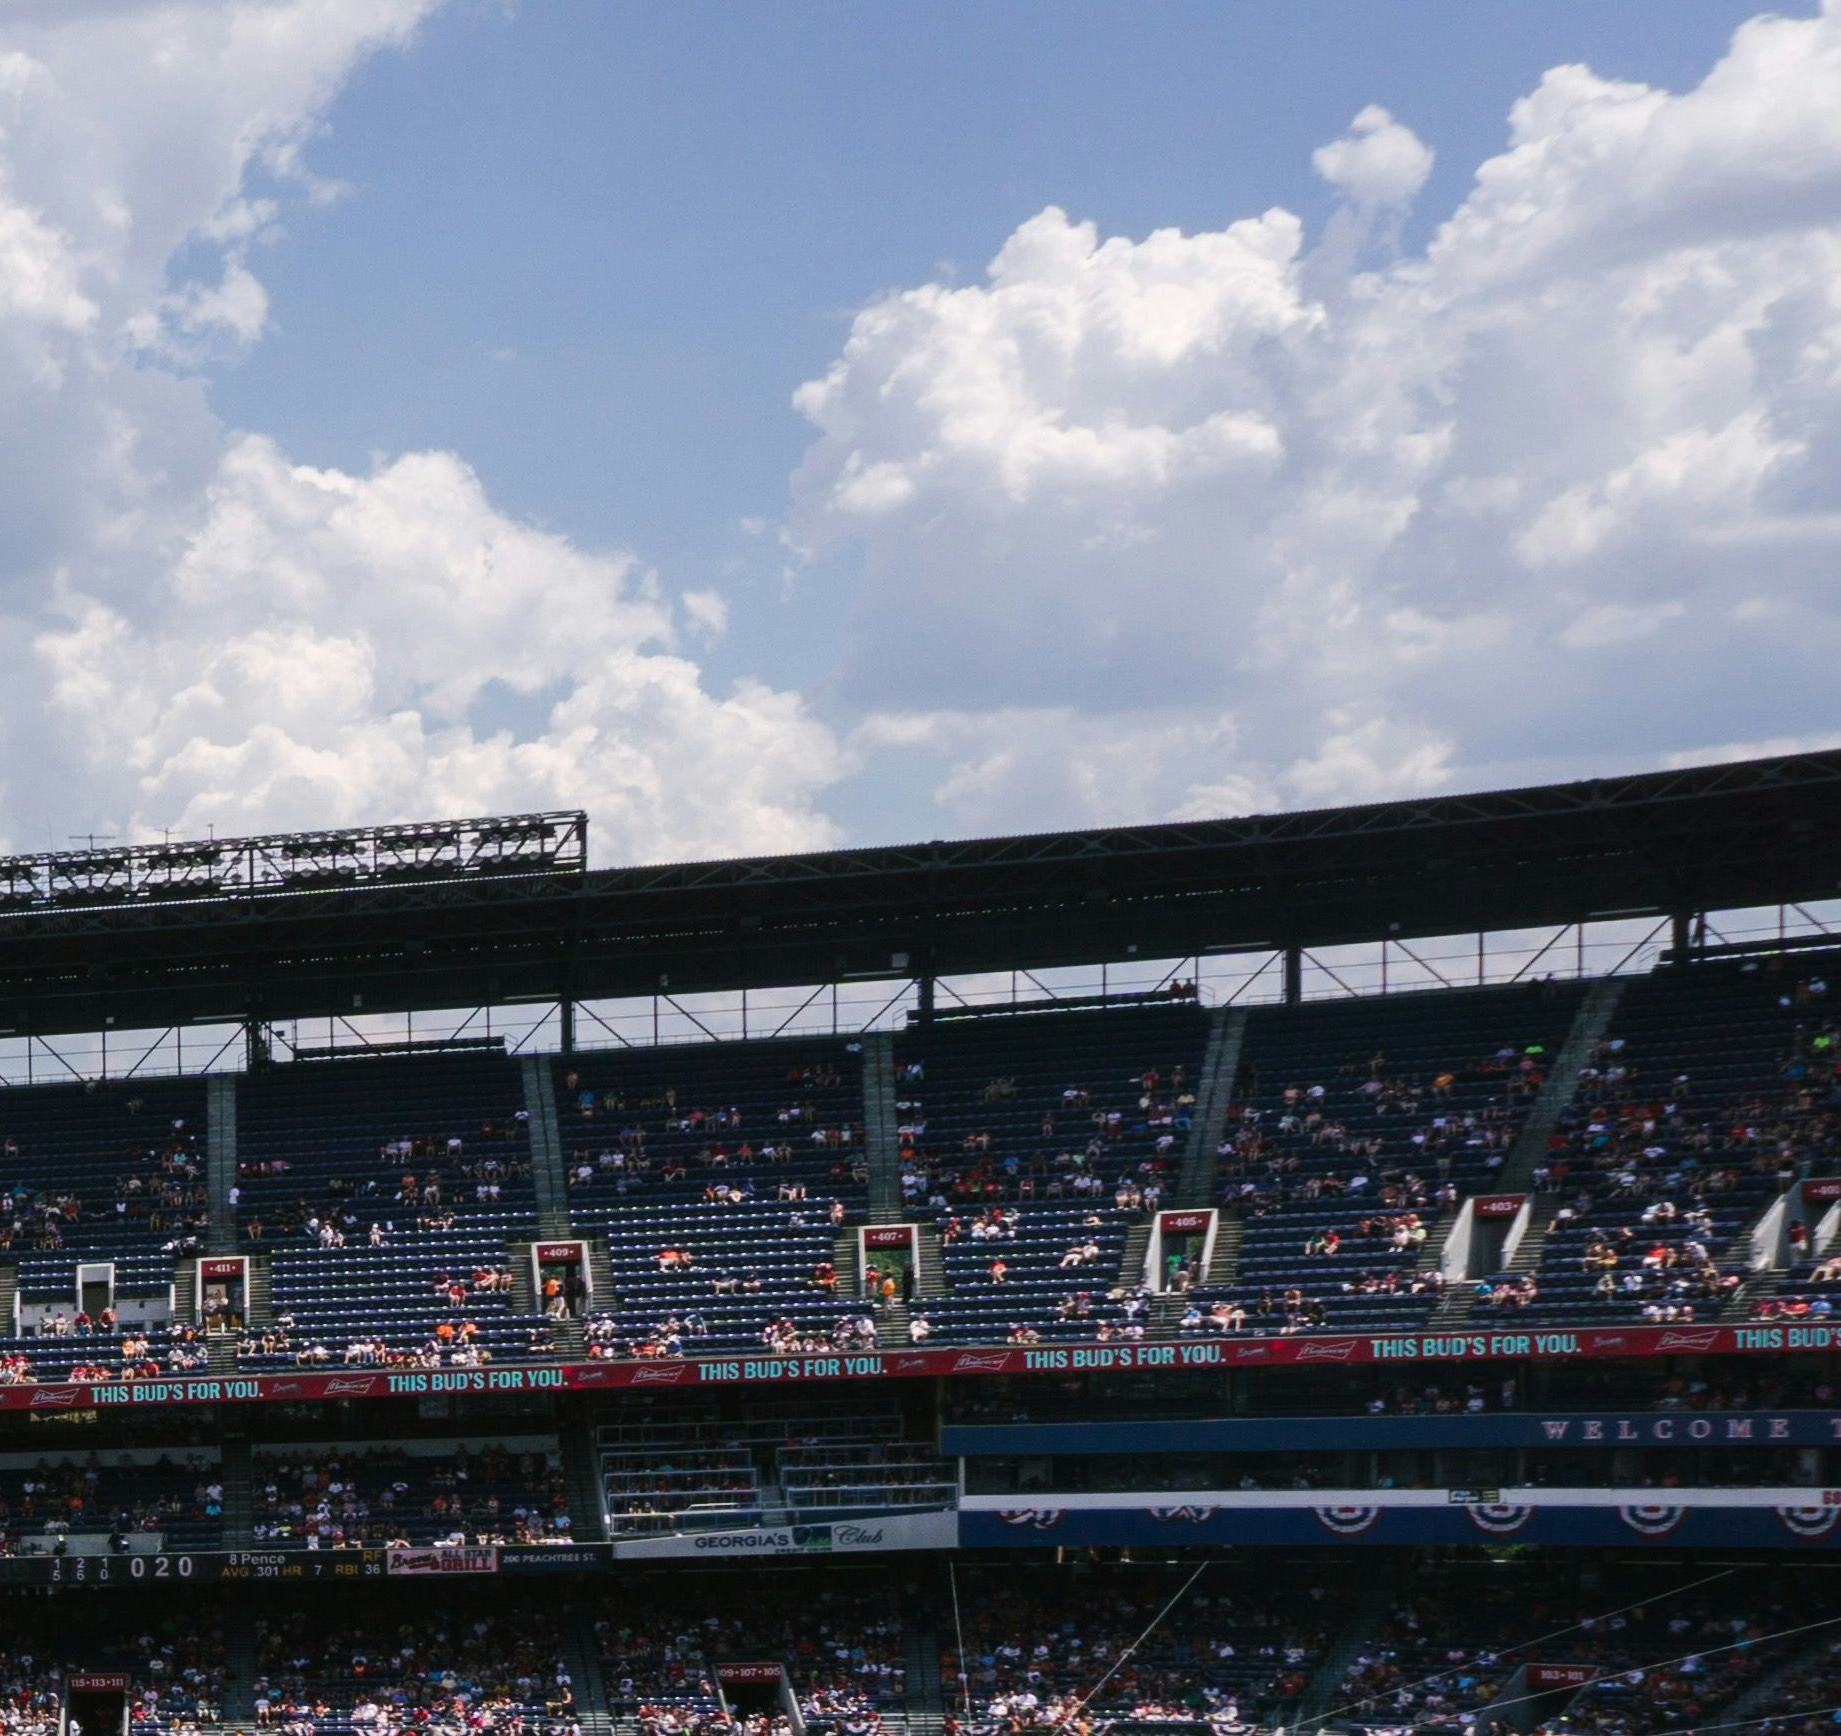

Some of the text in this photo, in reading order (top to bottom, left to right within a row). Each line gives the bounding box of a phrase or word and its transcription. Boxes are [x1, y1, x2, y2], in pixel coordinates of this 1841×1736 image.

[1371, 1335, 1581, 1357] THIS BUD'S FOR YOU.
[1024, 1351, 1068, 1368] THIS
[1073, 1349, 1132, 1367] BUD'S
[1137, 1347, 1175, 1364] FOR
[1180, 1346, 1226, 1363] YOU.
[698, 1358, 887, 1380] THIS BUD'S FOR YOU.
[388, 1370, 568, 1391] THIS BUD'S FOR YOU.
[91, 1382, 263, 1402] THIS BUD'S FOR YOU.
[1540, 1418, 1791, 1439] WELCOME
[694, 1533, 789, 1548] GEORGIA'S
[833, 1524, 884, 1545] Club
[241, 1554, 285, 1564] Pence
[363, 1550, 382, 1562] RF
[503, 1554, 520, 1564] 200
[522, 1554, 580, 1563] PEACHTREE
[222, 1566, 248, 1578] AVG
[283, 1566, 302, 1576] HR
[314, 1565, 322, 1576] 7
[335, 1564, 358, 1574] RBI
[365, 1564, 380, 1574] 36
